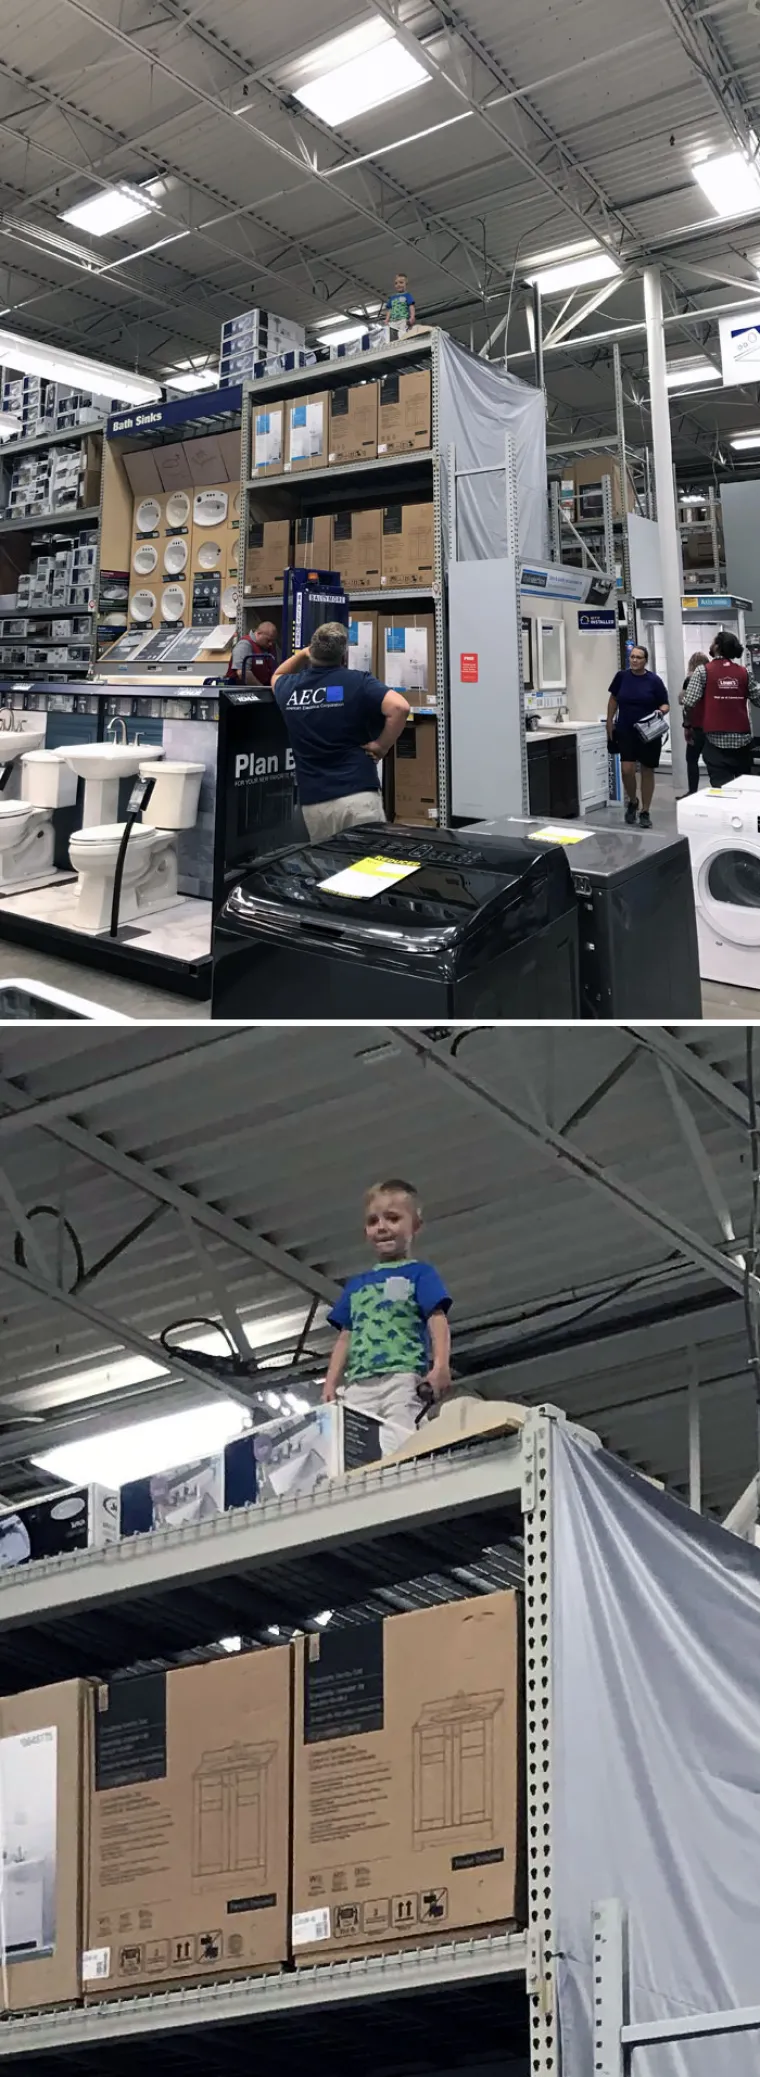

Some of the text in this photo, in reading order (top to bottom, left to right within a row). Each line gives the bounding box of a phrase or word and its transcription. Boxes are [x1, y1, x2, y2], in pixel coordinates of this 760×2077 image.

[113, 412, 162, 431] Bath Sinks
[286, 687, 326, 706] AEC
[235, 752, 279, 778] Plan
[245, 777, 258, 785] YOUR
[375, 855, 421, 867] REDUCED
